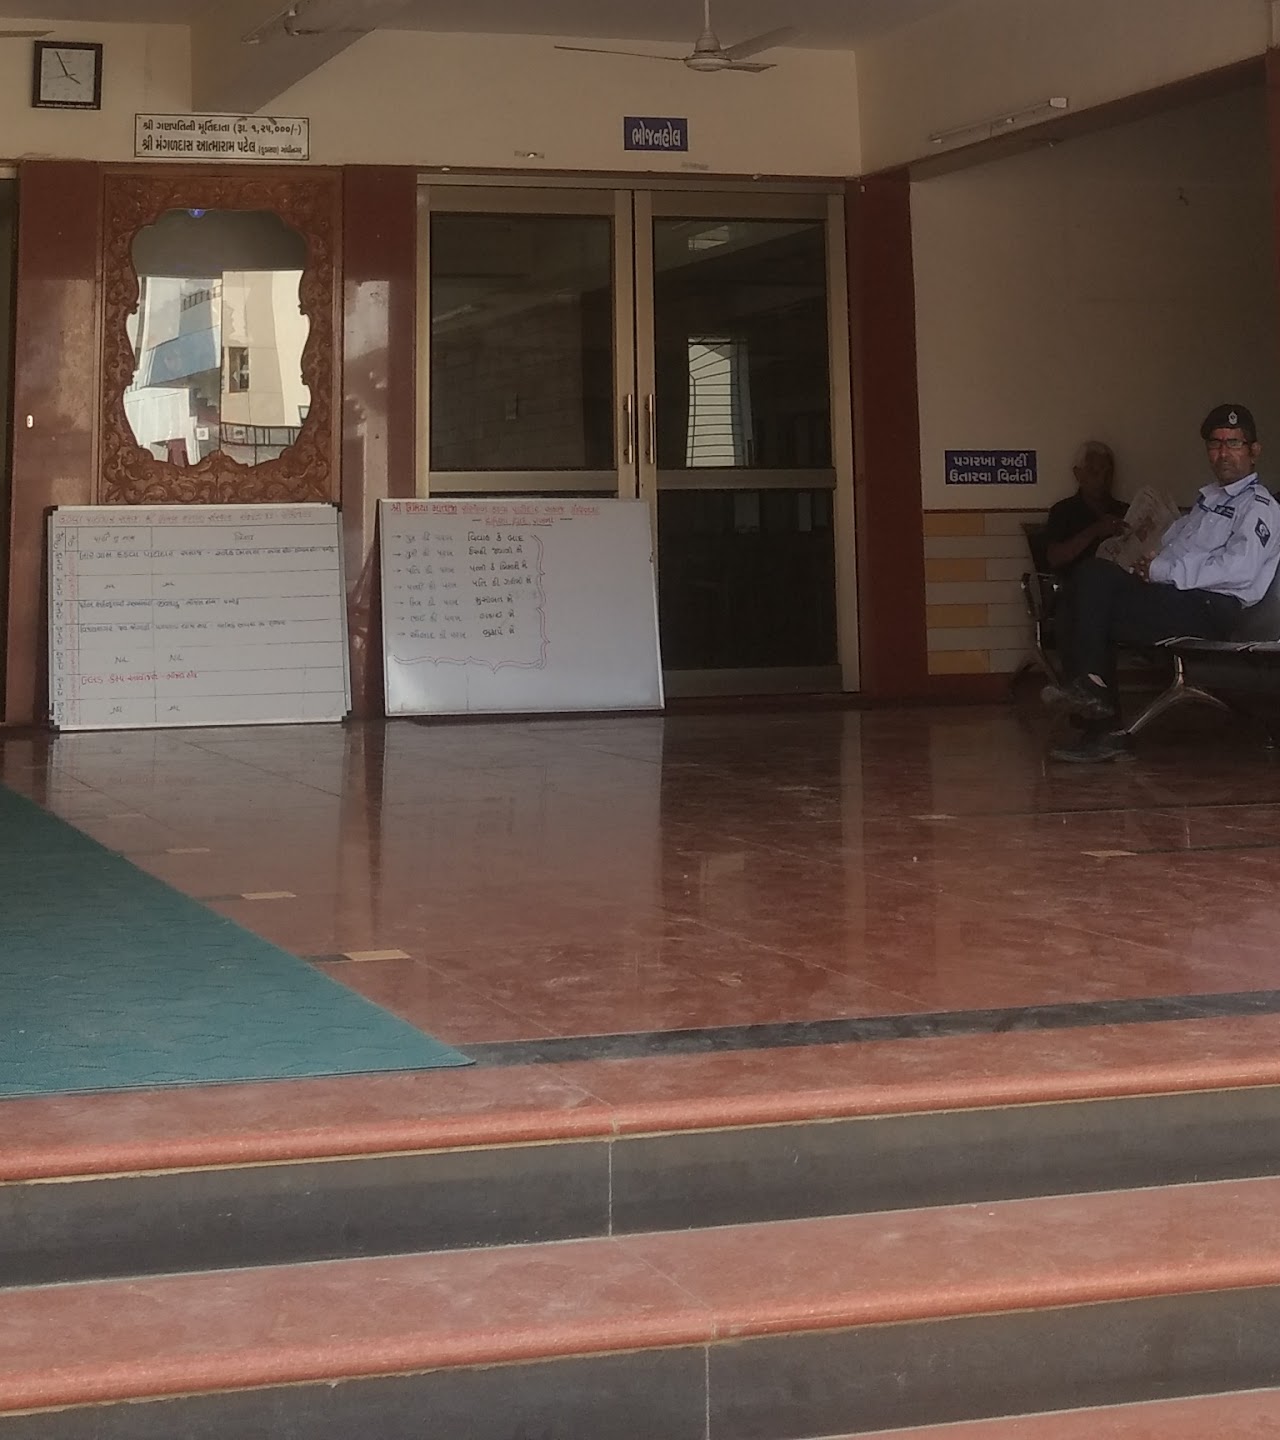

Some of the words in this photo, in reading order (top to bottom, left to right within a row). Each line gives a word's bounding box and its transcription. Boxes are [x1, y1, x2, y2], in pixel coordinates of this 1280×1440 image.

[143, 119, 154, 130] શ્રી
[632, 120, 681, 147] ભોજનહોલ
[142, 134, 153, 151] શ્રી
[156, 135, 193, 151] મંગળદાસ
[238, 136, 255, 152] પટેલ
[954, 456, 995, 467] પગરખા
[949, 469, 991, 482] ઉતારવા
[997, 469, 1033, 483] વિનંતી
